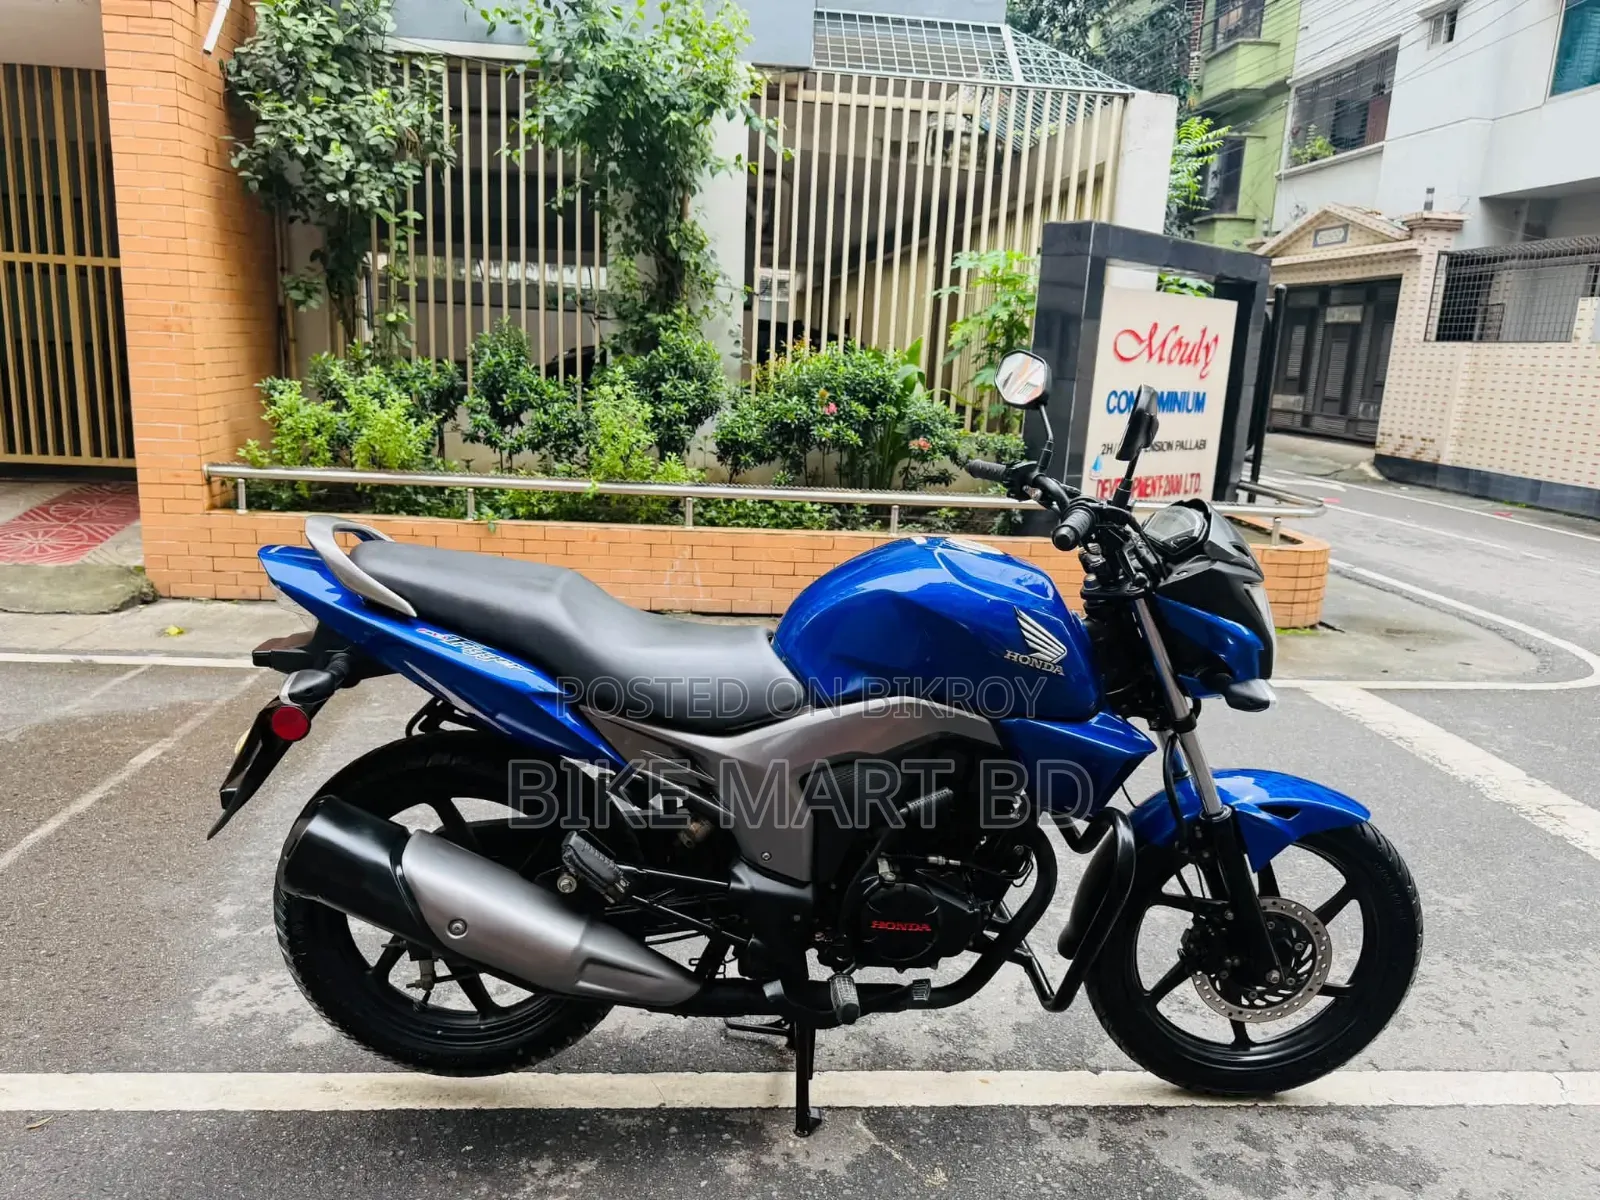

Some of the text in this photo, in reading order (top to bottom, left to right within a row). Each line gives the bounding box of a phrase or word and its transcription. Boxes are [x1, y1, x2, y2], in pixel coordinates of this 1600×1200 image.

[1113, 322, 1219, 379] Mouly
[1106, 390, 1206, 414] CONMINIUM
[1003, 649, 1065, 676] HONDA
[871, 920, 932, 932] HONDA
